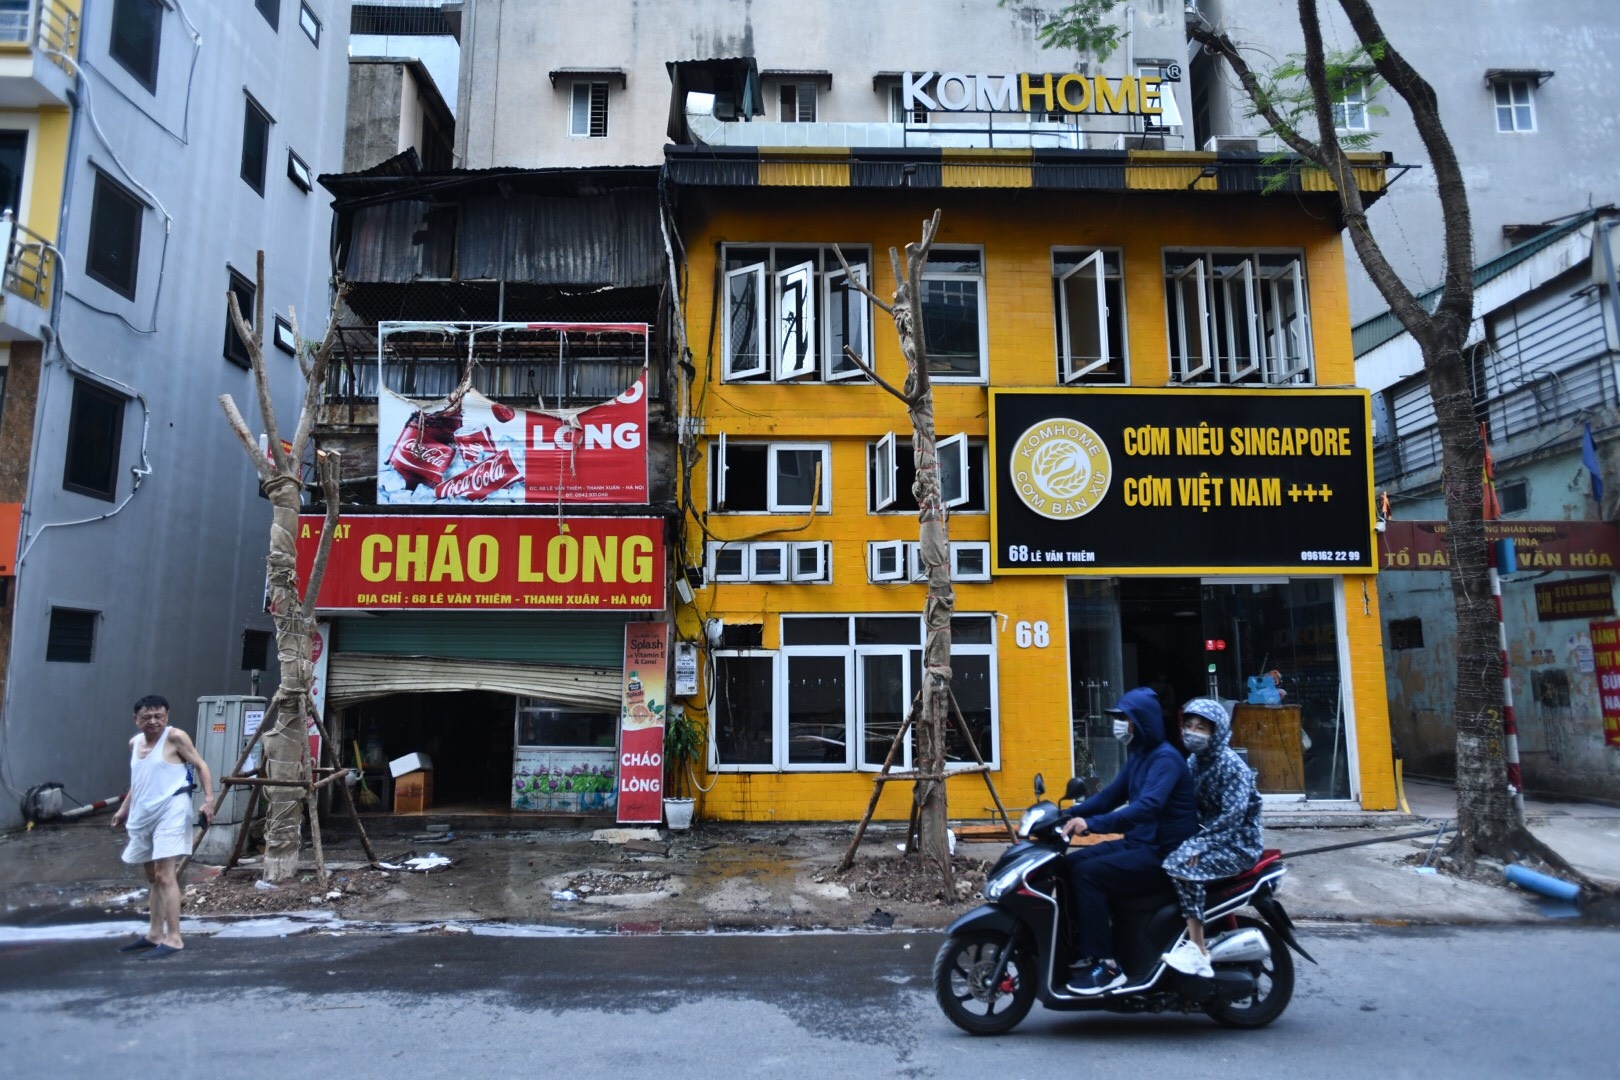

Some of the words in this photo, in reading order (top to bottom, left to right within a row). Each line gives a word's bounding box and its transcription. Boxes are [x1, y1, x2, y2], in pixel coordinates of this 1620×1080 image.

[902, 71, 1163, 114] KOMHOME
[1021, 425, 1100, 457] KOMHOME
[1123, 425, 1170, 456] CƠM
[1176, 421, 1224, 456] NIÊU
[1230, 427, 1352, 457] SINGAPORE
[1123, 475, 1172, 506] CƠM
[1178, 472, 1224, 513] VIỆT
[1230, 478, 1281, 506] NAM
[360, 523, 500, 583] CHÁO
[517, 522, 654, 584] LÒNG
[1008, 544, 1029, 562] 68
[1030, 550, 1042, 562] LÊ
[1045, 549, 1064, 562] VĂN
[1066, 550, 1095, 562] THIÊM
[1335, 551, 1347, 561] 22
[1348, 551, 1360, 561] 99
[1384, 547, 1410, 566] TỔ
[1519, 549, 1562, 566] VĂN
[1569, 549, 1612, 566] HÓA
[357, 593, 377, 606] ĐỊA
[411, 594, 426, 604] 68
[430, 592, 443, 604] LÊ
[447, 592, 471, 604] VĂN
[474, 593, 512, 604] THIÊM
[523, 595, 563, 605] THANH
[566, 593, 599, 605] XUÂN
[611, 592, 627, 605] HÀ
[631, 594, 652, 607] NỘI
[1015, 621, 1050, 648] 68
[630, 640, 663, 652] Splash
[660, 651, 665, 659] E
[621, 750, 661, 767] CHÁO
[621, 776, 660, 792] LÒNG
